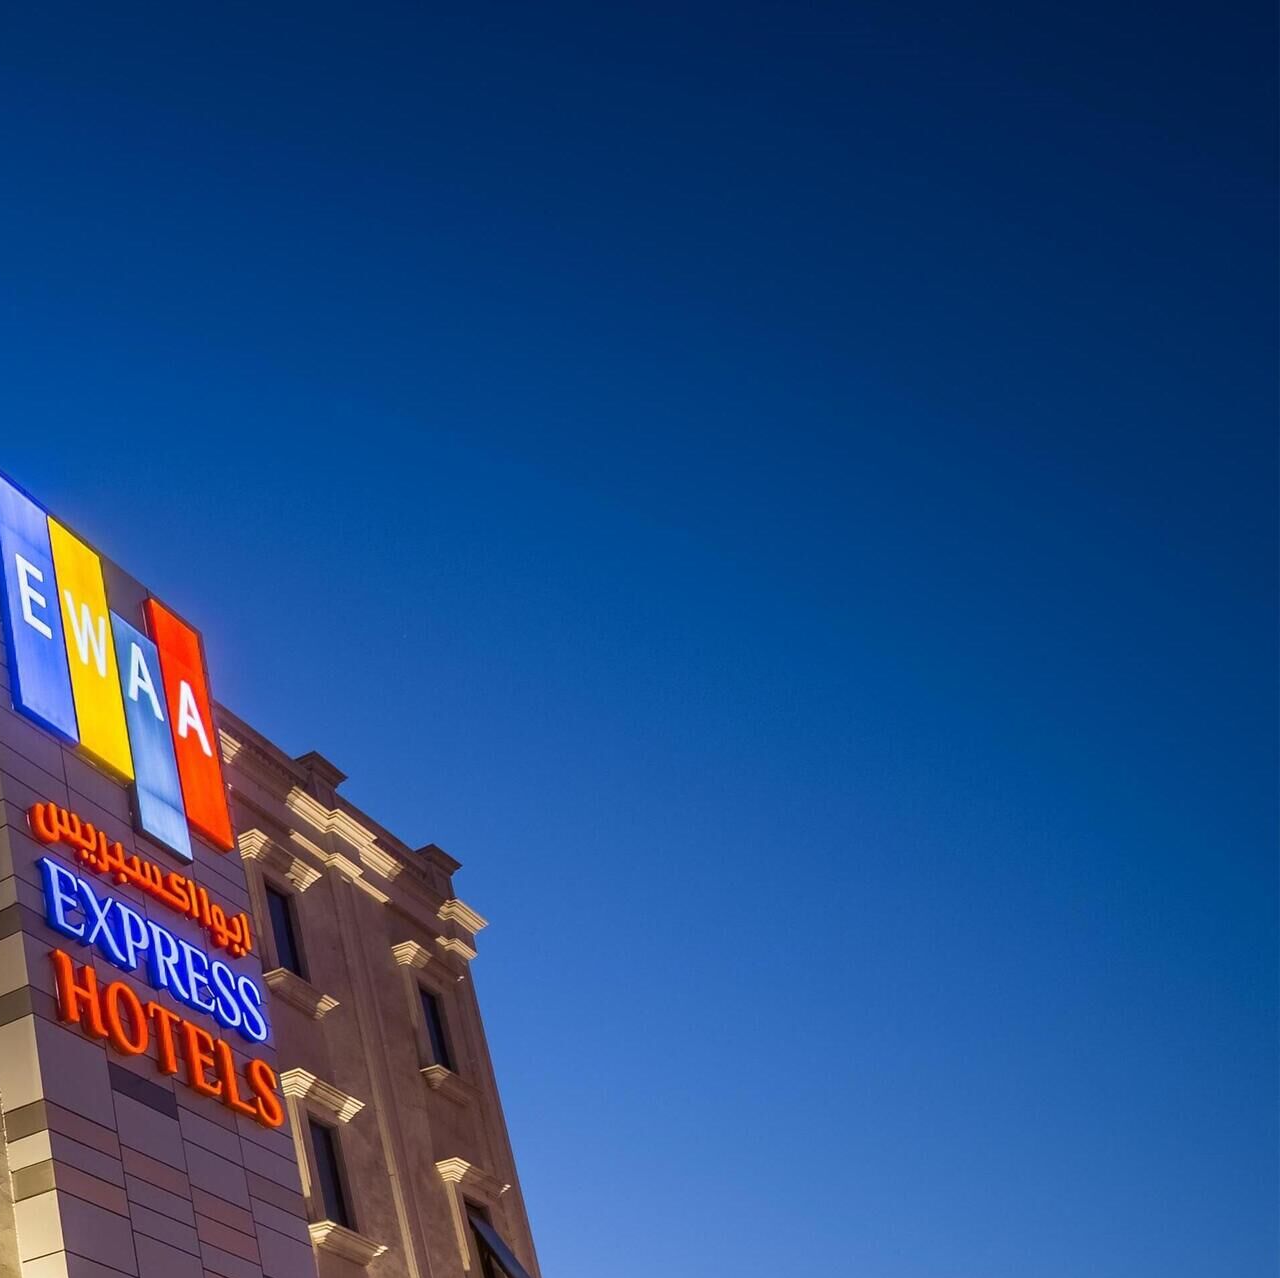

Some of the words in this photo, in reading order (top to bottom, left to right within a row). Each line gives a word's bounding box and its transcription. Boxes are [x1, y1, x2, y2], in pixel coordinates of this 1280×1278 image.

[15, 552, 212, 758] EWAA
[37, 856, 268, 1043] EXPRESS
[48, 948, 285, 1128] HOTELS
